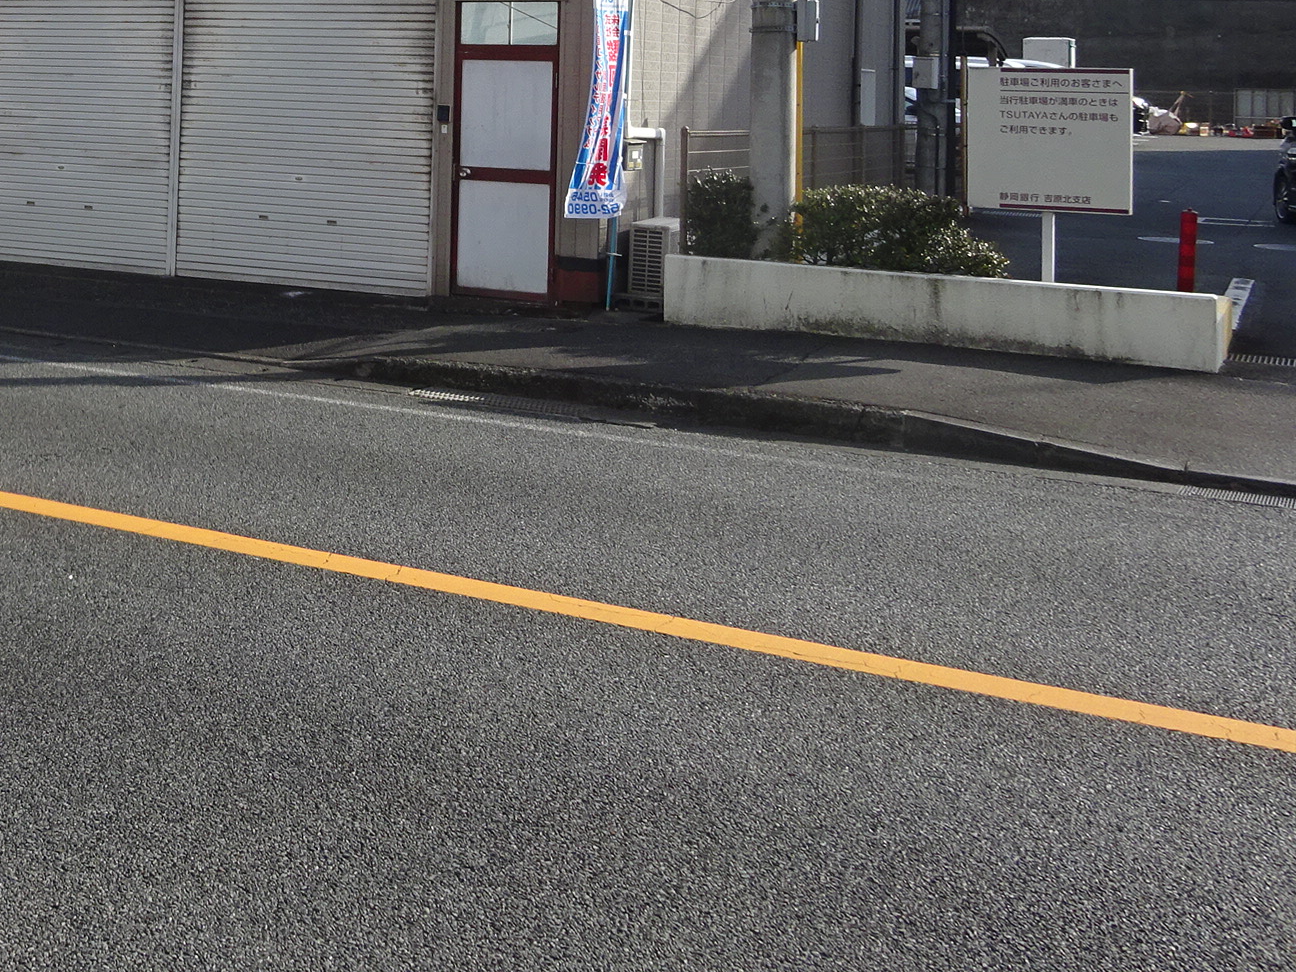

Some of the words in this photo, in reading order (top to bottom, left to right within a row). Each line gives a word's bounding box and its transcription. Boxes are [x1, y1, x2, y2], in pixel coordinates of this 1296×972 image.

[999, 76, 1123, 89] 駐車場ご利用のお客さまへ
[999, 95, 1119, 107] 当行駐車場が満車のときは
[999, 110, 1120, 122] TSUTAYAさんの駐車場も
[999, 124, 1073, 136] ご利用できます。
[999, 192, 1040, 203] 静岡銀行
[1044, 193, 1092, 205] 吉原北支店
